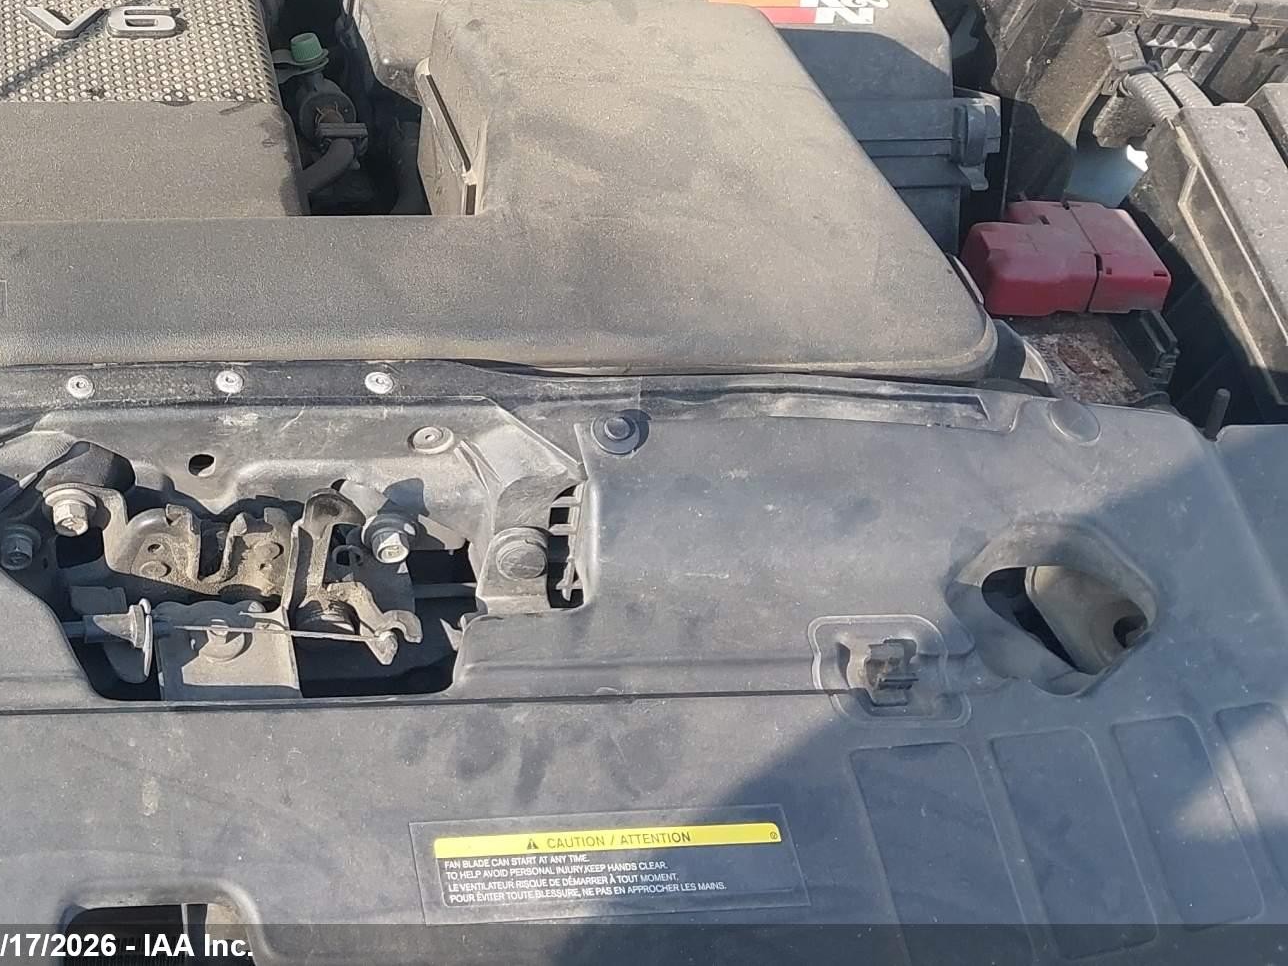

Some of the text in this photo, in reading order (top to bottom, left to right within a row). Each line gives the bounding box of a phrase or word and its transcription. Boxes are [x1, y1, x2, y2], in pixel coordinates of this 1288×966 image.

[19, 5, 180, 38] V6
[546, 835, 605, 849] CAUTION
[620, 831, 692, 845] ATTENTION
[444, 854, 590, 869] FAN BLADE CAN START AT ANY TIME.
[445, 871, 458, 880] TO
[460, 870, 482, 879] HELP
[483, 868, 508, 878] AVOID
[510, 867, 555, 876] PERSONAL
[607, 862, 638, 872] HANDS
[638, 861, 669, 870] CLEAR.
[448, 873, 679, 893] LE VENTILATEUR RISQUE DE DÉMARRER À TOUT MOMENT.
[450, 882, 727, 903] POUR ÉVITER TOUTE BLESSURE, NE PAS EN APPROCHER LES MAINS.
